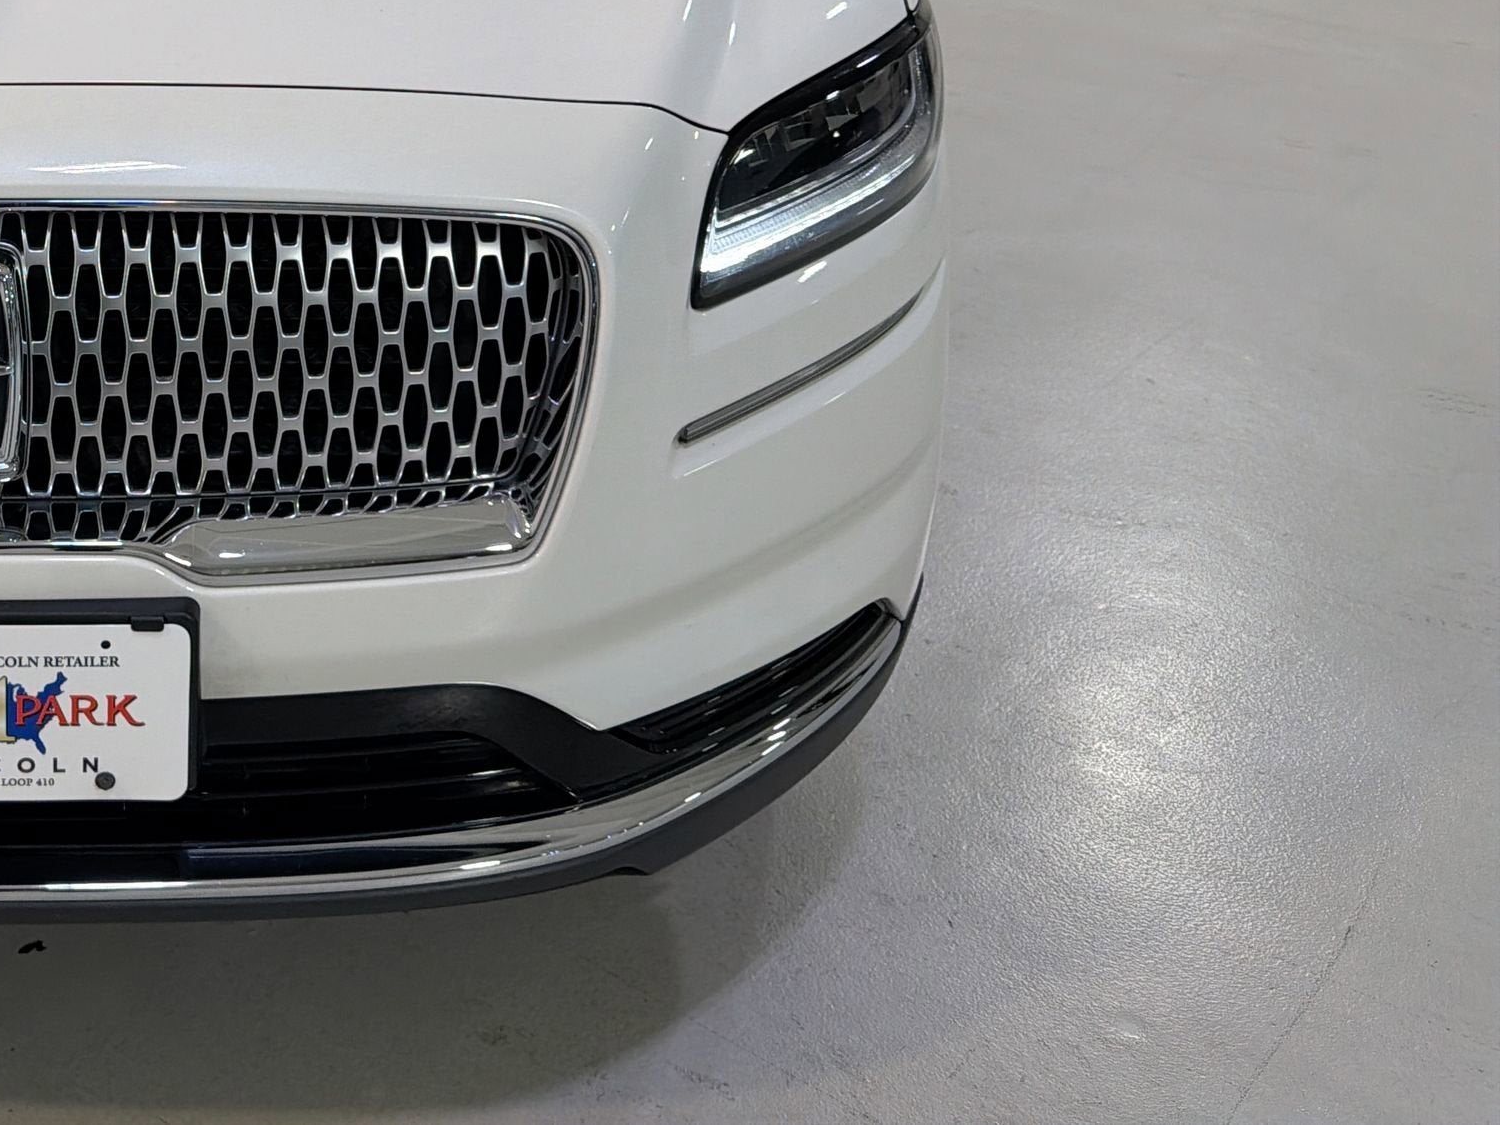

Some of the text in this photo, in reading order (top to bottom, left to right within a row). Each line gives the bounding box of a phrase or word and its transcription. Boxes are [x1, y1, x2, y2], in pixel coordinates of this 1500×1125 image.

[43, 655, 120, 668] RETAILER
[15, 693, 146, 727] PARK
[1, 777, 34, 787] LOOP
[36, 777, 56, 787] 410
